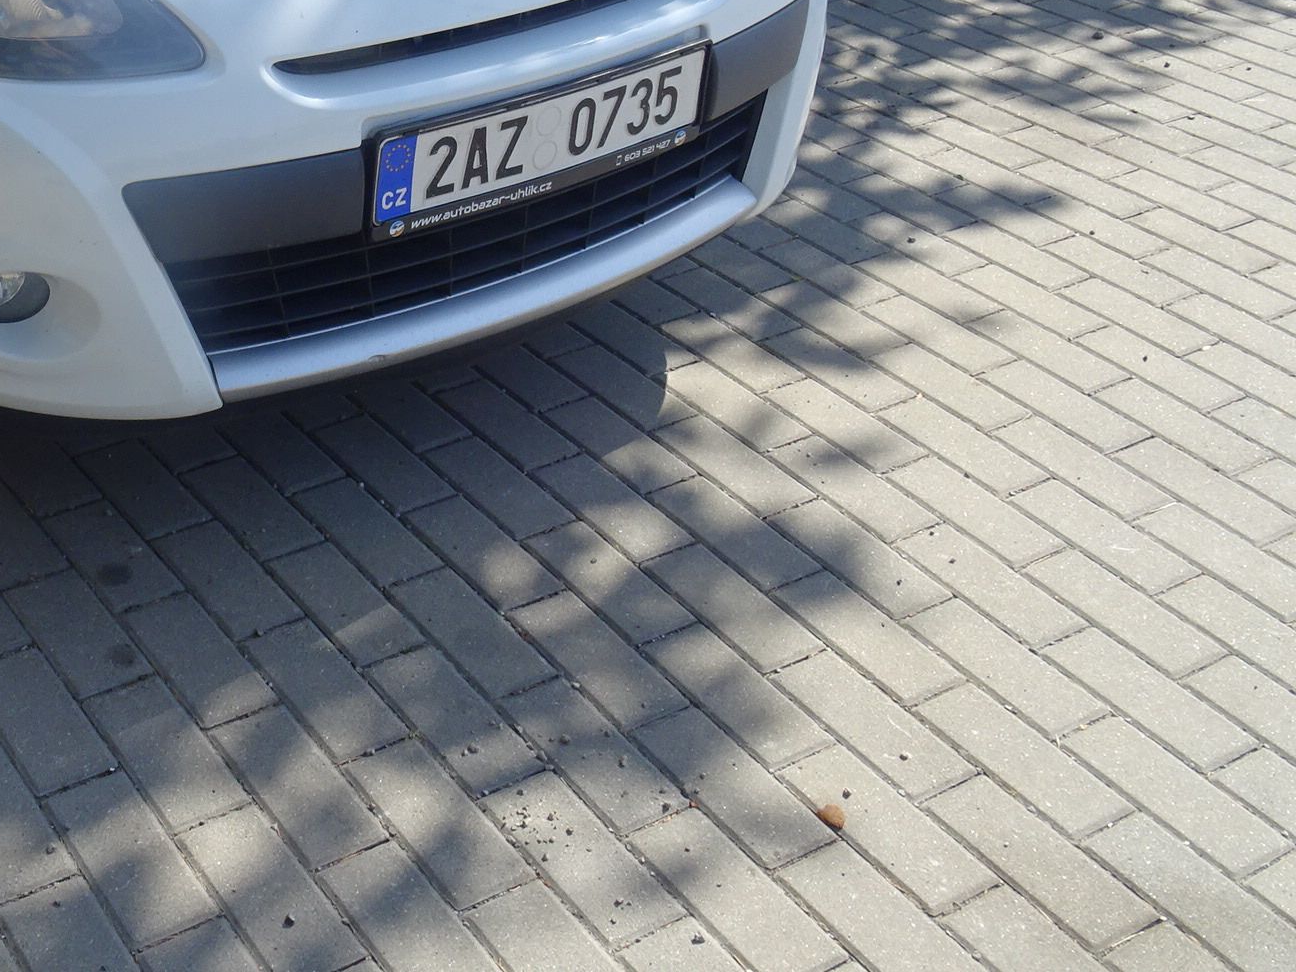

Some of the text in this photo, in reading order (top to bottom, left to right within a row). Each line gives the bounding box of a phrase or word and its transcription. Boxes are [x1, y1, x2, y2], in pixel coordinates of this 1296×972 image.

[425, 66, 683, 199] 2AZ 0735
[381, 187, 408, 211] CZ
